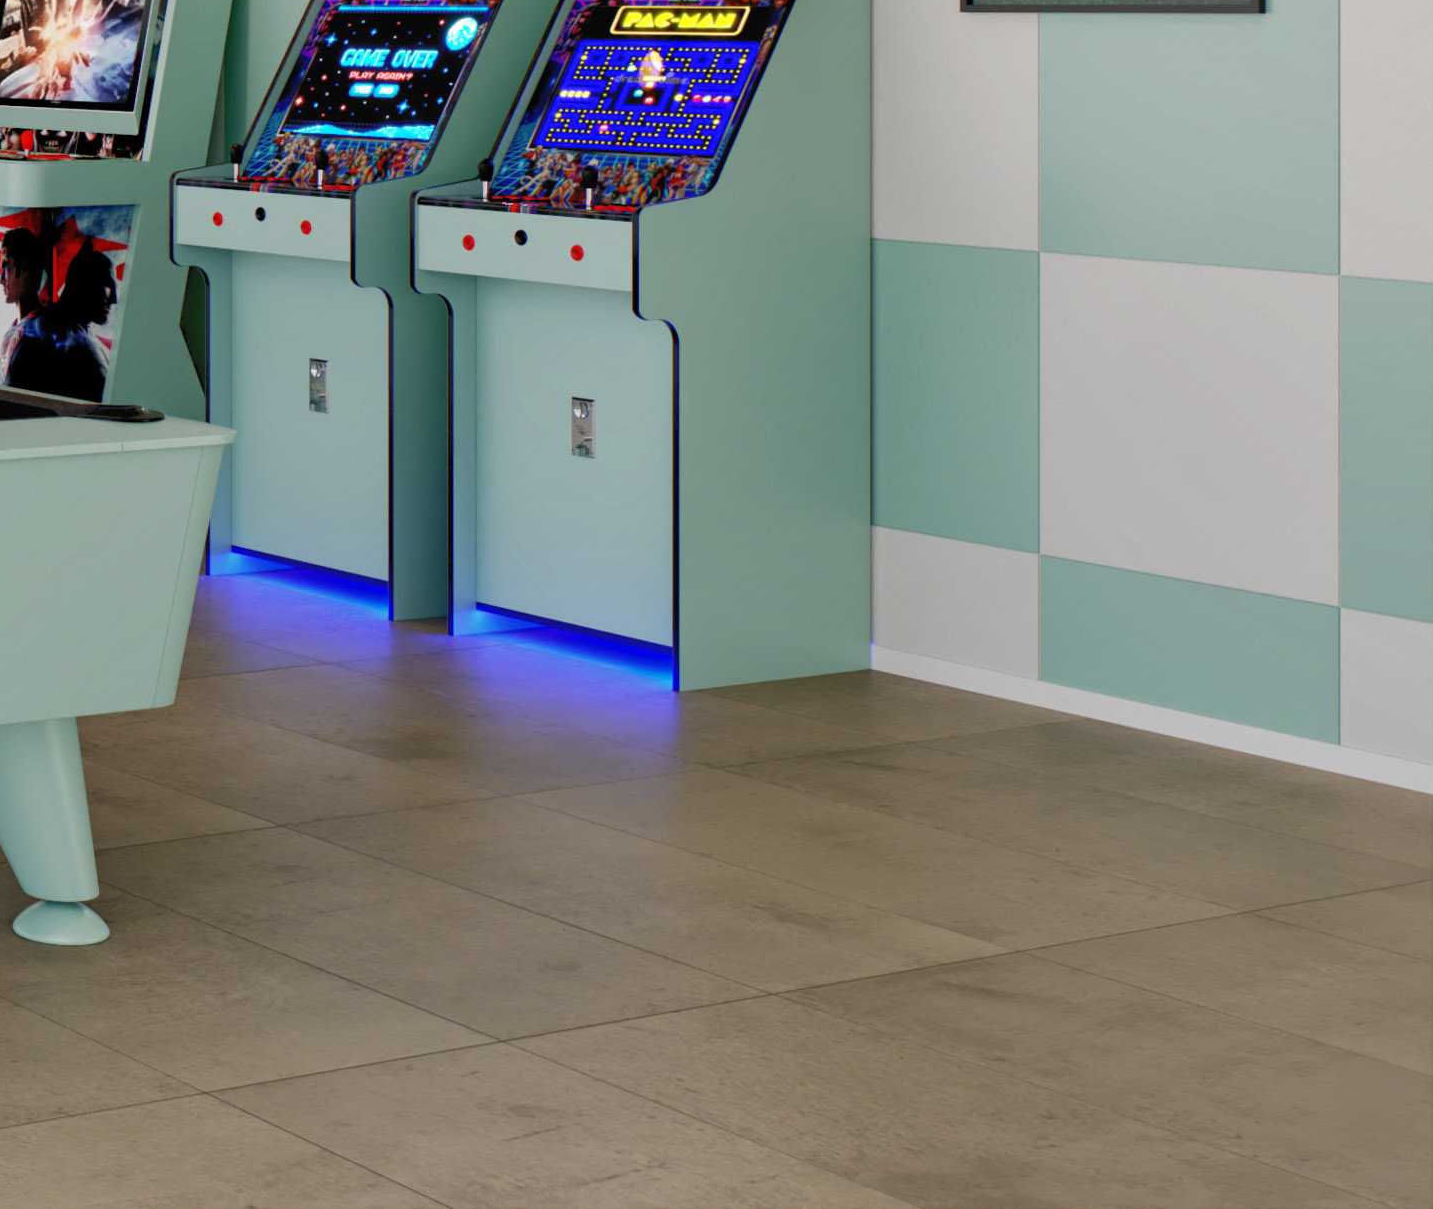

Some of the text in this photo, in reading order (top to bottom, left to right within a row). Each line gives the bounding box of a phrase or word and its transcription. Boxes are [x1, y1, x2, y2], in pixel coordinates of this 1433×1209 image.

[622, 11, 737, 29] PAC-MAN
[339, 48, 439, 69] GAME OVER
[348, 70, 414, 81] PLAY AGAIN?
[354, 85, 395, 95] YES NO
